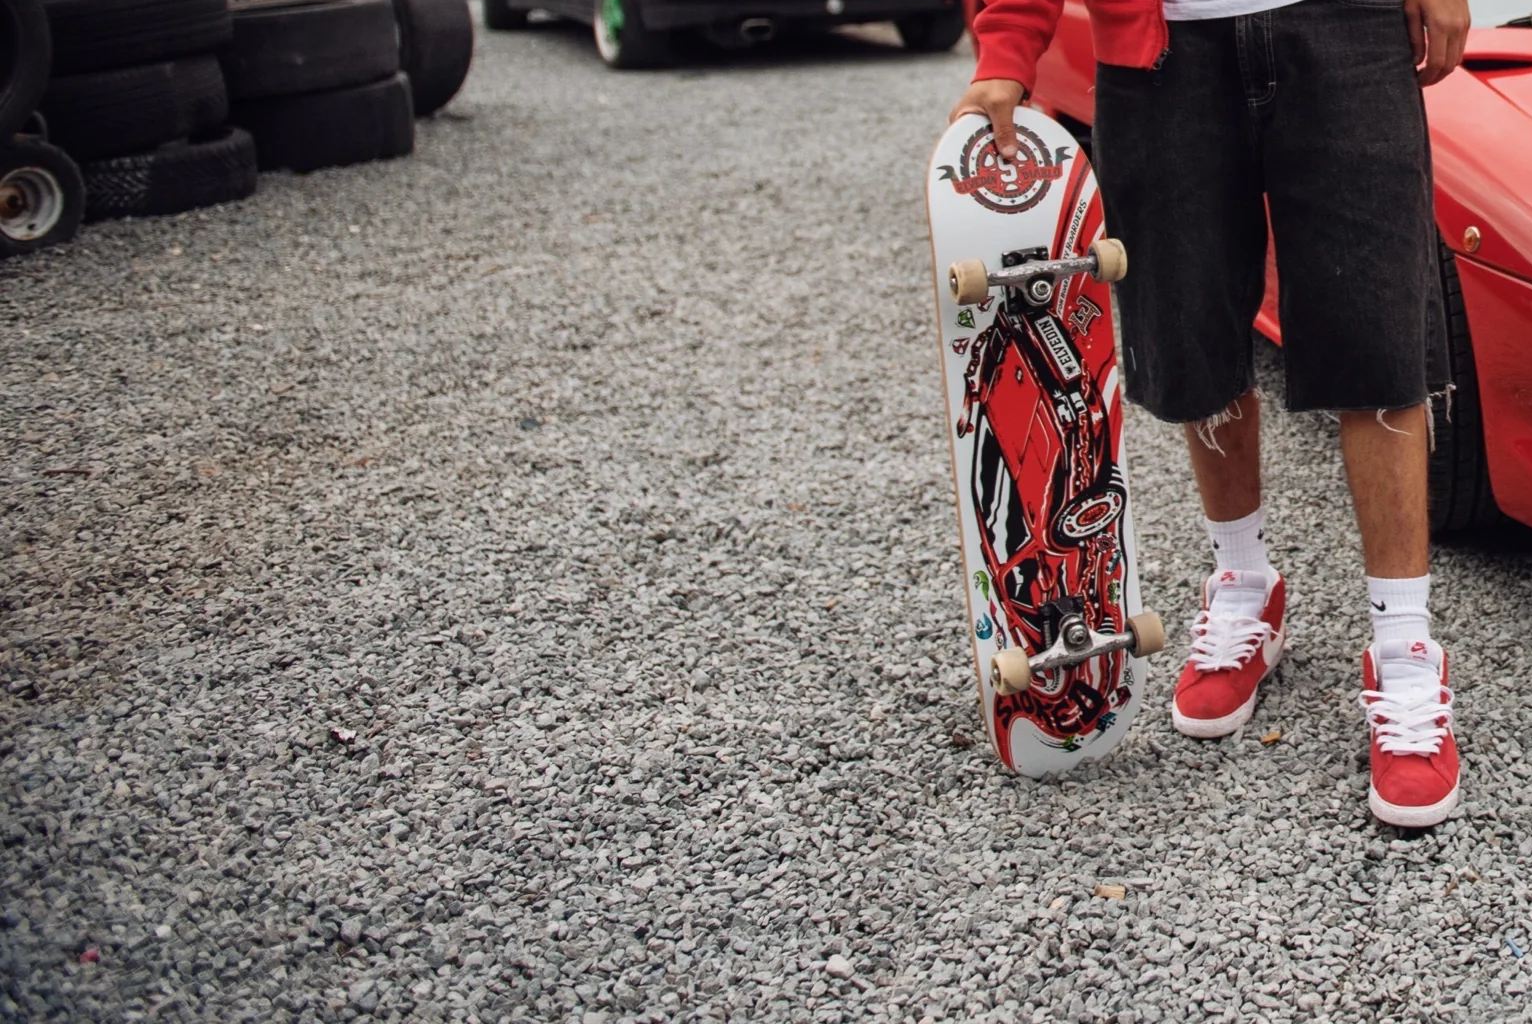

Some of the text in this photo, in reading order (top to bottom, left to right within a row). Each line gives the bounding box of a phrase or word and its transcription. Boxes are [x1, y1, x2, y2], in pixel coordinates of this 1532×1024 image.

[1021, 167, 1061, 180] DIABLO
[1065, 198, 1088, 254] BOARDERS
[1038, 319, 1073, 366] ELVEDIN
